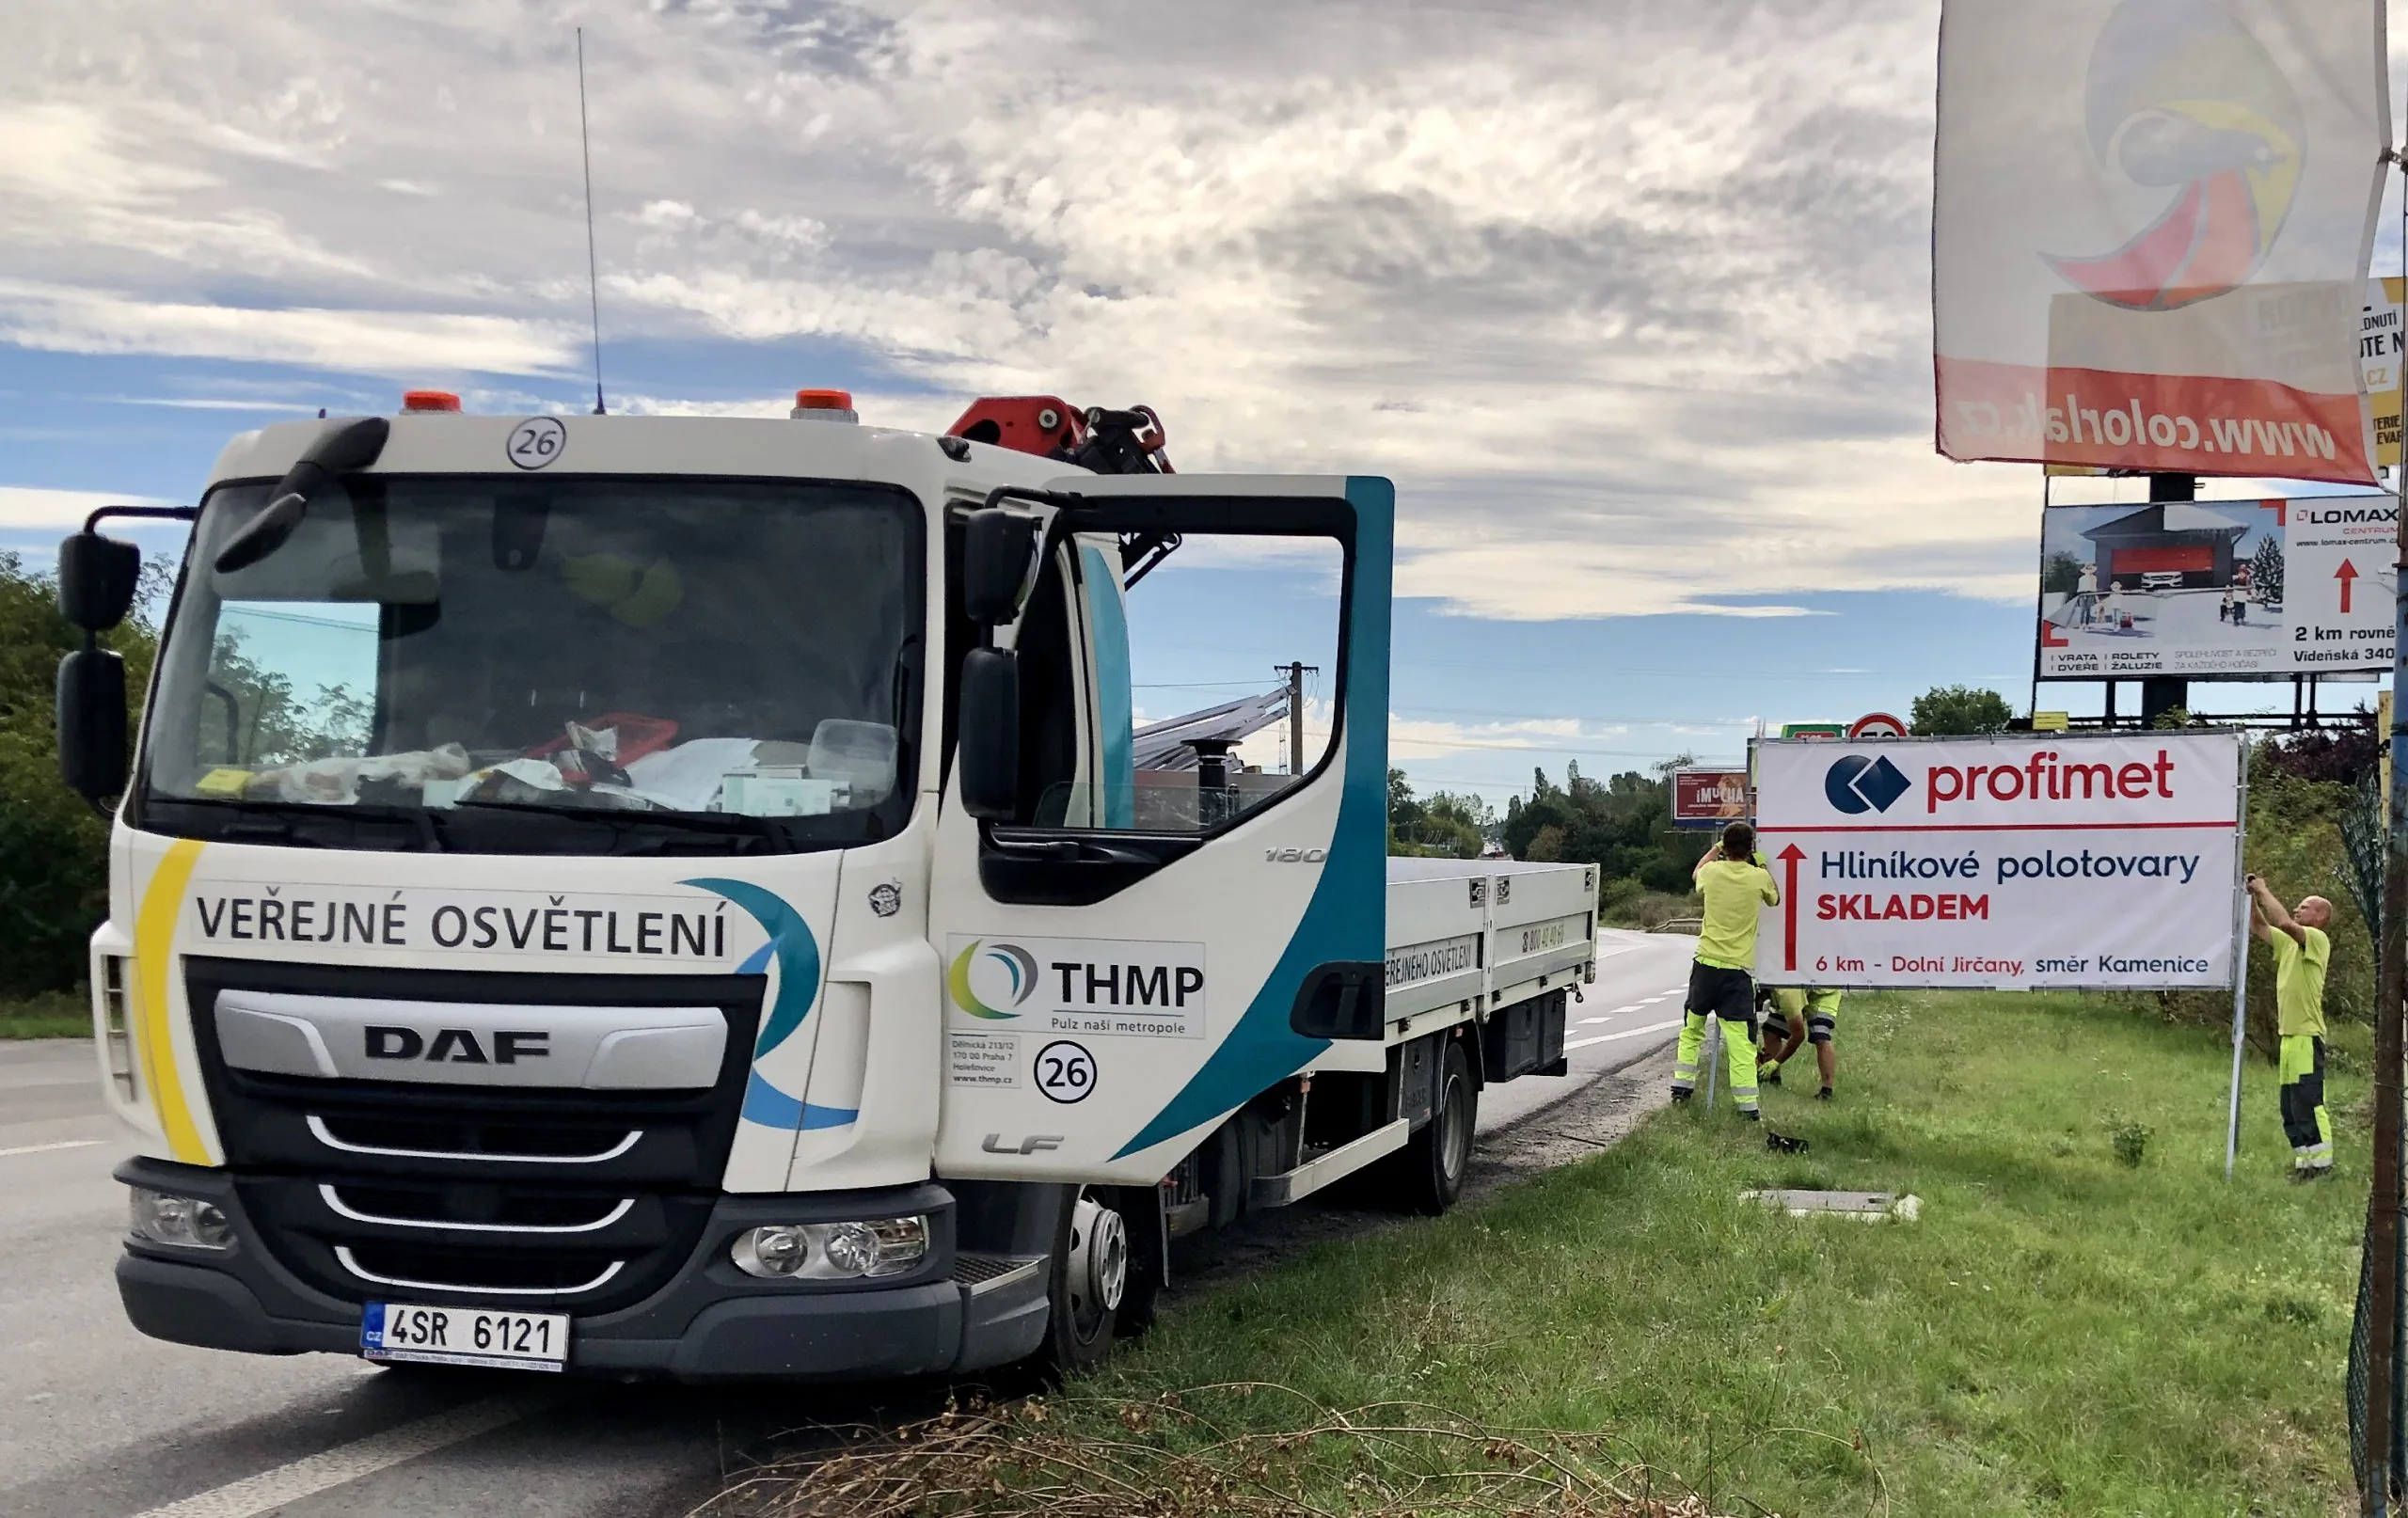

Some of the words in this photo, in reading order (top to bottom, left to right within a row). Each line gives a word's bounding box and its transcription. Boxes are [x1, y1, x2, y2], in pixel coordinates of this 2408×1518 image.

[2360, 308, 2397, 331] DNUTÍ
[515, 429, 557, 455] 26
[2310, 509, 2399, 524] LOMAX
[2295, 626, 2307, 641] 2
[2315, 625, 2342, 640] km
[2350, 625, 2396, 640] rovně
[2058, 653, 2099, 662] VRATA
[2112, 652, 2161, 660] ROLETY
[2293, 648, 2359, 662] Vídeňská
[2365, 647, 2395, 659] 340
[2058, 661, 2099, 672] DVEŘE
[2111, 660, 2163, 671] ŽALUZIE
[1926, 750, 2175, 814] profimet
[1265, 846, 1328, 863] 180
[1820, 849, 1980, 879] Hliníkové
[1997, 848, 2200, 885] polotovary
[1816, 893, 1989, 921] SKLADEM
[197, 885, 406, 945] VEŘEJNÉ
[432, 894, 727, 958] OSVĚTLENÍ
[1815, 956, 1828, 972] 6
[1835, 956, 1865, 972] km
[1892, 955, 1945, 973] Dolní
[1951, 955, 2025, 976] Jirčany,
[2035, 954, 2089, 973] směr
[2099, 954, 2210, 974] Kamenice
[1051, 962, 1204, 1007] THMP
[1052, 1018, 1079, 1030] Pulz
[1084, 1019, 1111, 1031] naší
[1116, 1021, 1185, 1035] metropole
[364, 1024, 550, 1066] DAF
[982, 1052, 1005, 1061] Praha
[953, 1075, 1013, 1083] www.thmp.cz
[1044, 1057, 1087, 1088] 26
[981, 1132, 1065, 1155] LF
[366, 1330, 383, 1341] CZ
[391, 1309, 449, 1347] 4SR
[474, 1315, 550, 1353] 6121
